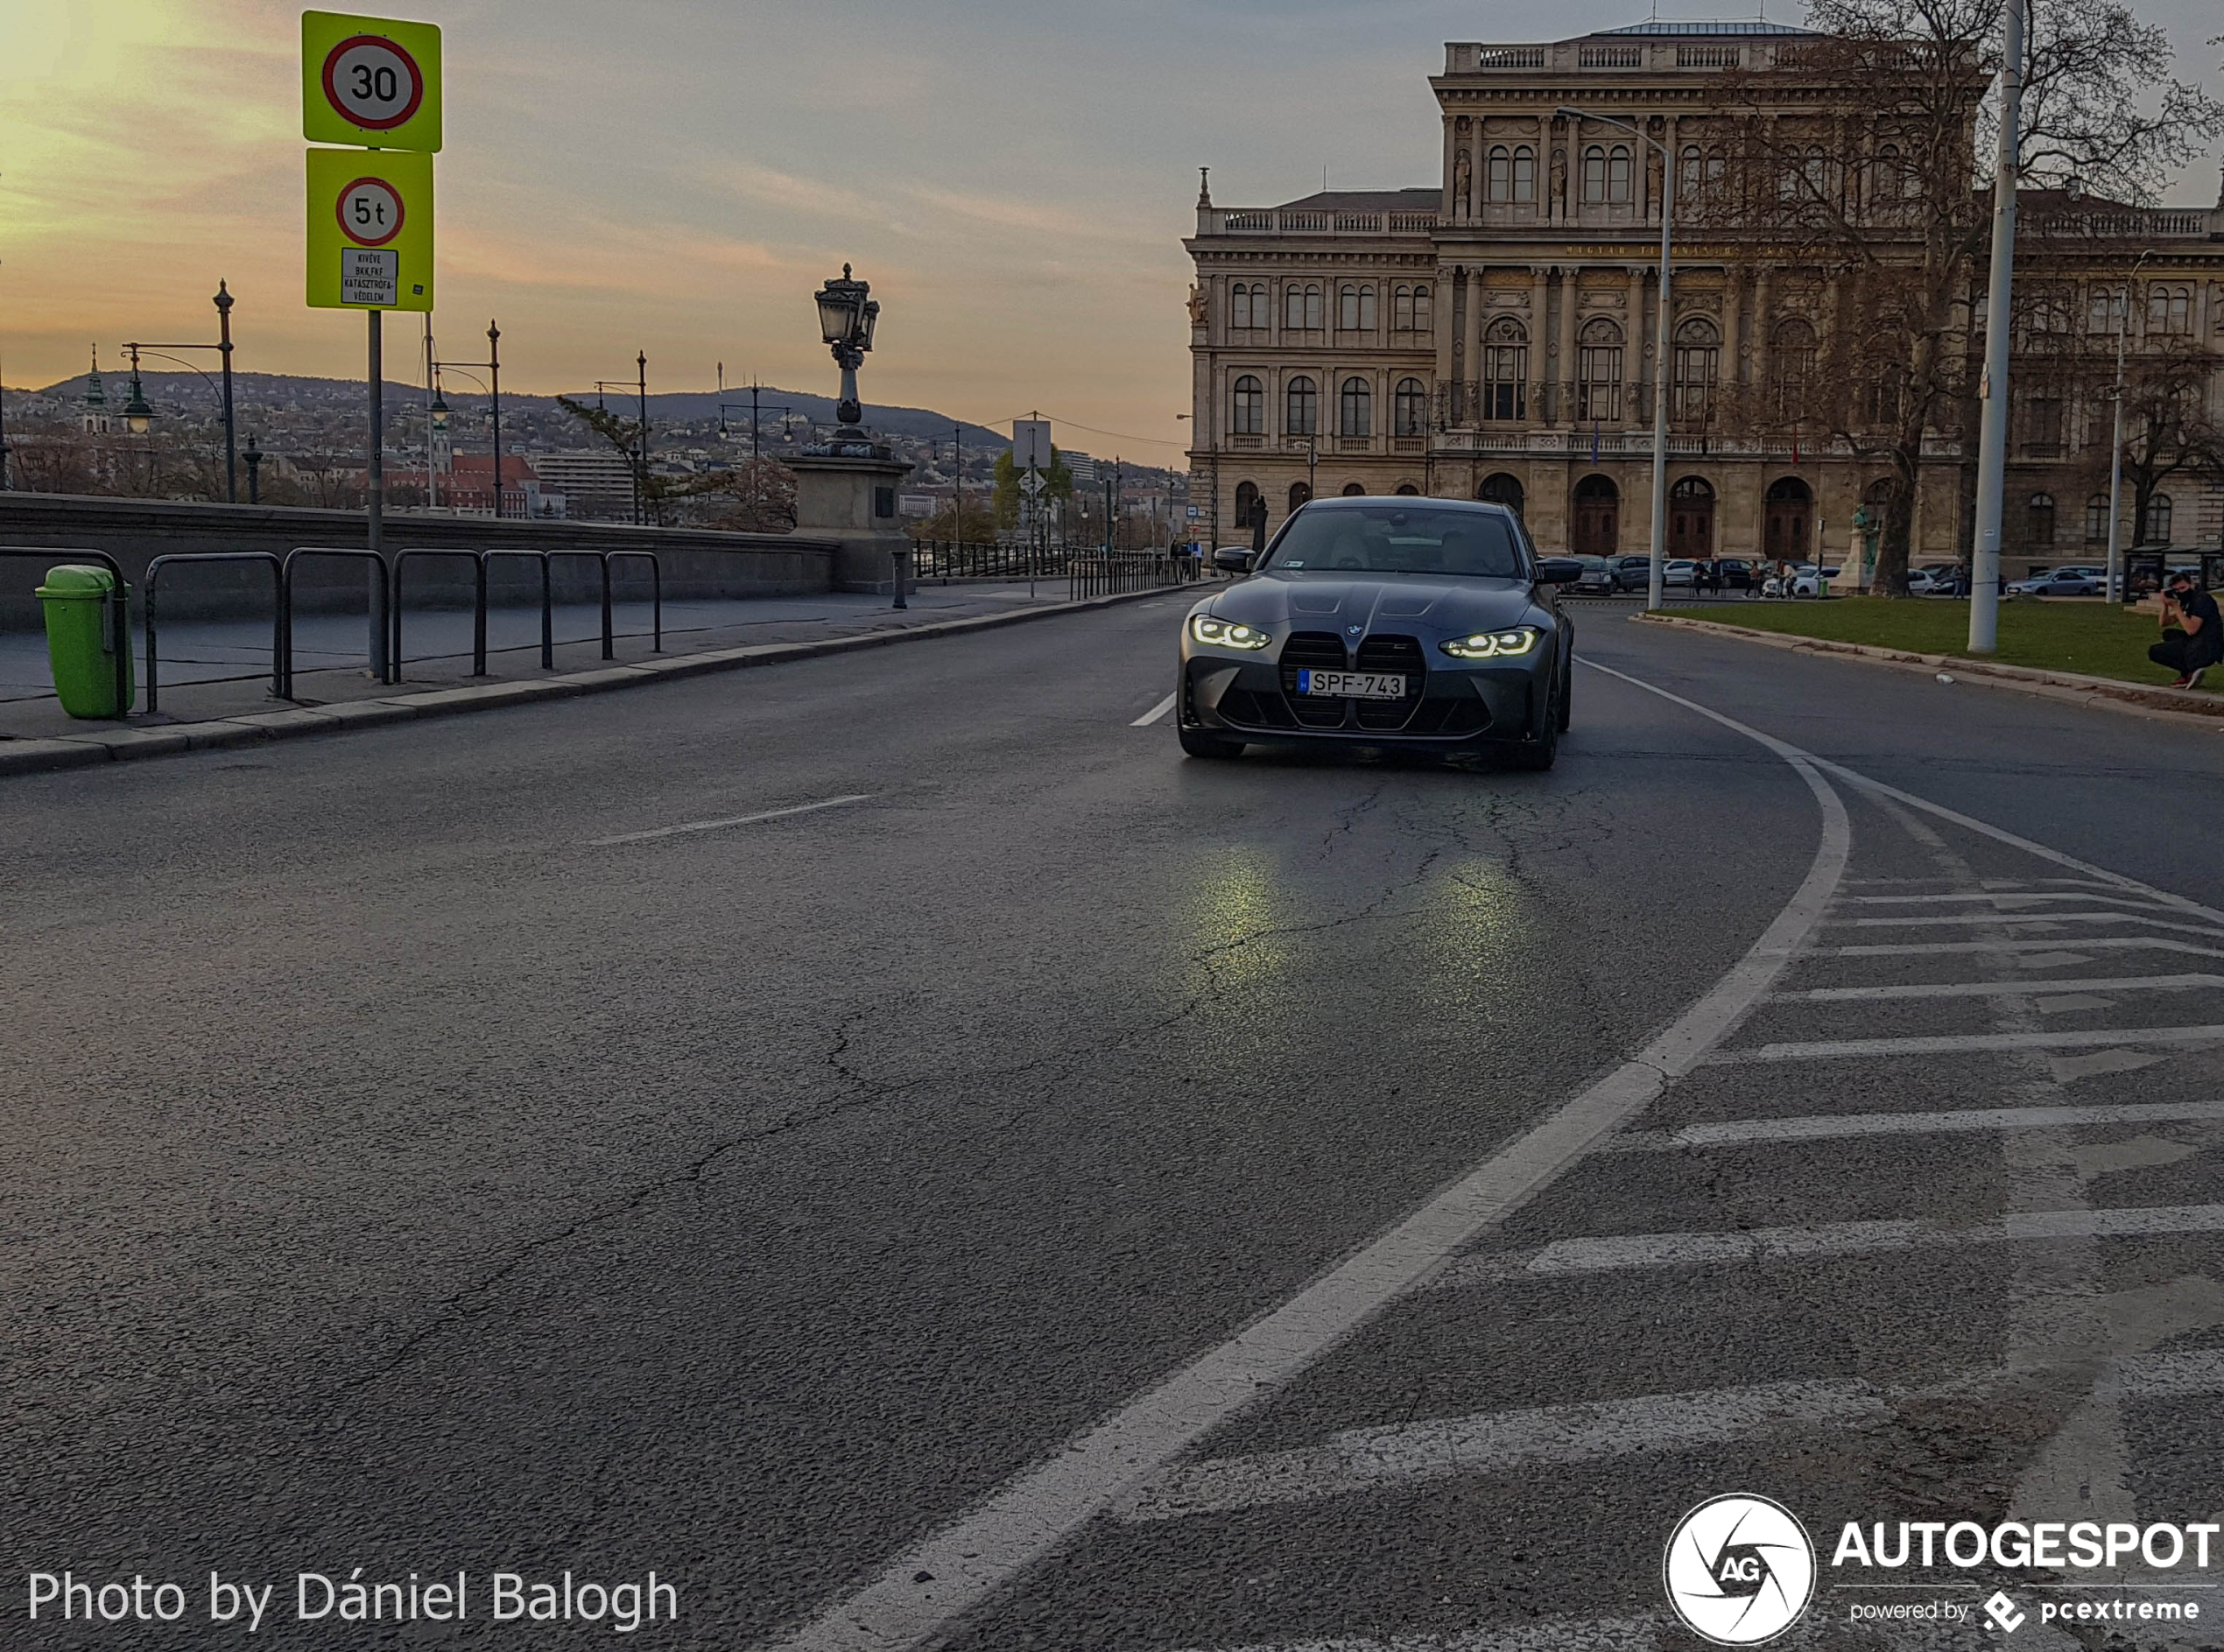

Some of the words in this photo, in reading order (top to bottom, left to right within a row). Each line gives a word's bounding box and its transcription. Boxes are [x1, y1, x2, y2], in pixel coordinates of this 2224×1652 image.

[351, 64, 397, 102] 30
[355, 198, 371, 225] 5
[376, 202, 384, 225] t
[358, 252, 381, 264] KIVÉVE
[354, 290, 384, 302] VÉDELEM
[1313, 673, 1401, 694] SPF-743
